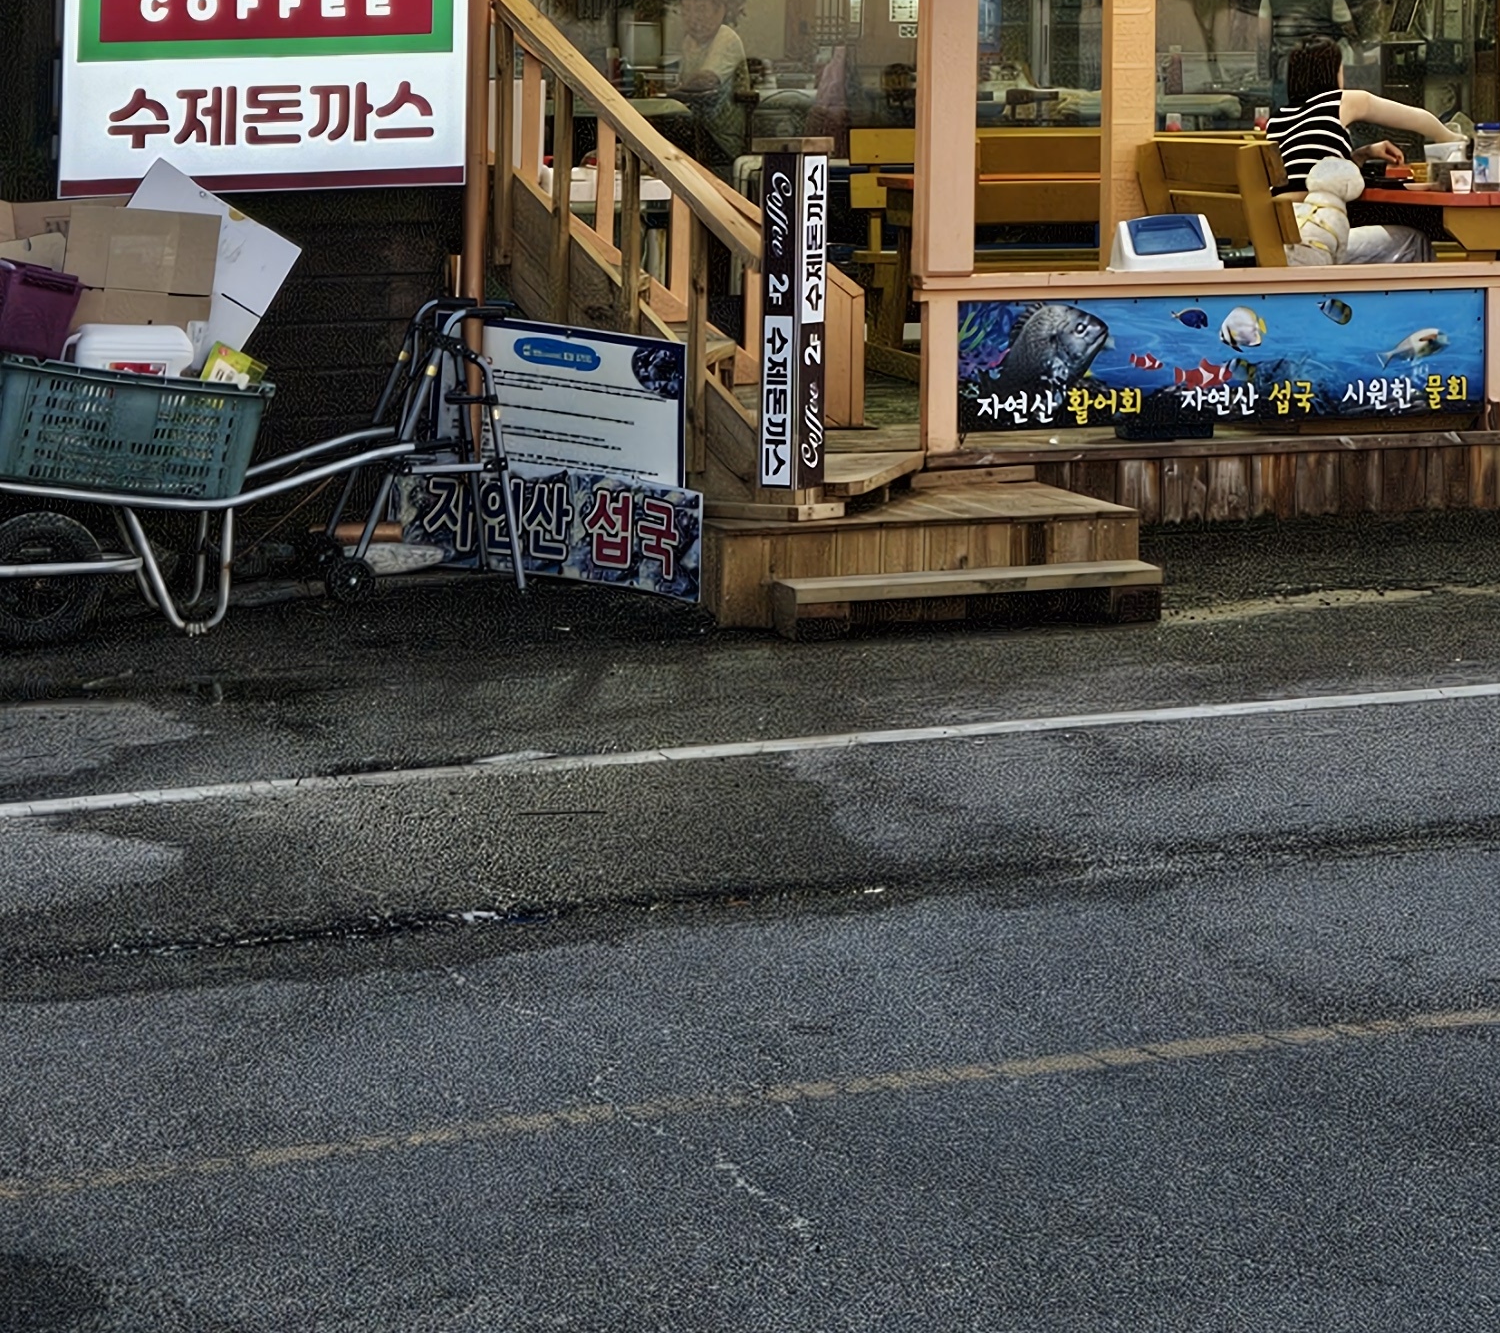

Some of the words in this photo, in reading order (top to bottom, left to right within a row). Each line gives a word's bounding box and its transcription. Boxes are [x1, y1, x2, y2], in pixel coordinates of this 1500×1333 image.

[107, 80, 435, 149] 수제돈까스
[805, 164, 825, 312] 수제돈까스
[768, 273, 789, 306] 2F
[804, 333, 821, 366] 2F
[765, 326, 789, 478] 수제돈까스
[977, 390, 1057, 424] 자연산
[1067, 386, 1141, 425] 활어회
[1181, 381, 1259, 416] 자연산
[1268, 379, 1315, 414] 섭국
[1342, 377, 1412, 410] 시원한
[1425, 374, 1468, 409] 물회
[423, 476, 573, 561] 자연산
[584, 489, 679, 580] 섭국
